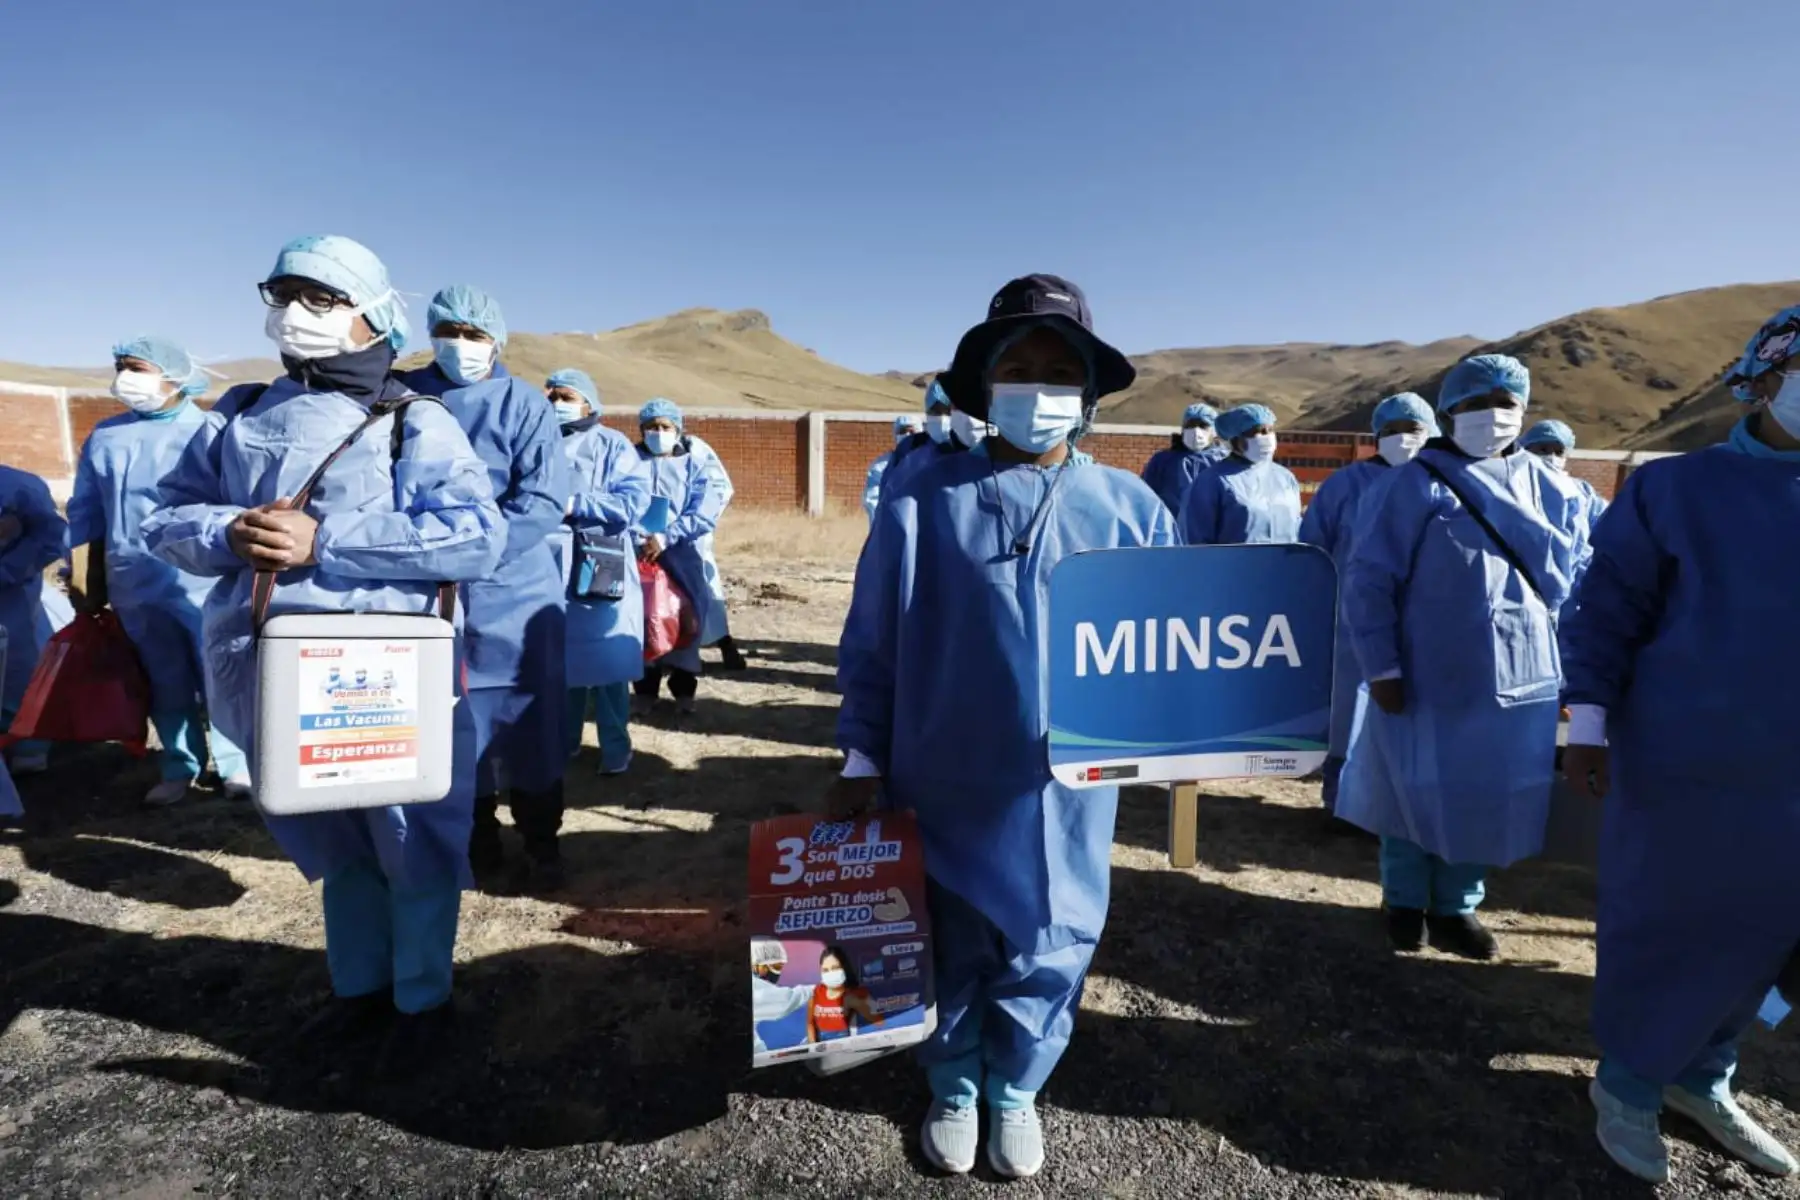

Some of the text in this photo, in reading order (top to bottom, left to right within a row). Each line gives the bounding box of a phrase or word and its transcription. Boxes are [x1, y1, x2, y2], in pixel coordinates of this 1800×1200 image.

[1075, 614, 1302, 677] MINSA
[314, 713, 408, 728] Las Vacunas
[312, 742, 407, 761] Esperanza
[770, 837, 806, 885] 3
[807, 843, 898, 863] Son MEJOR
[804, 864, 876, 887] que DOS
[784, 889, 885, 910] Ponte Tu dosis
[780, 906, 871, 929] REFUERZO
